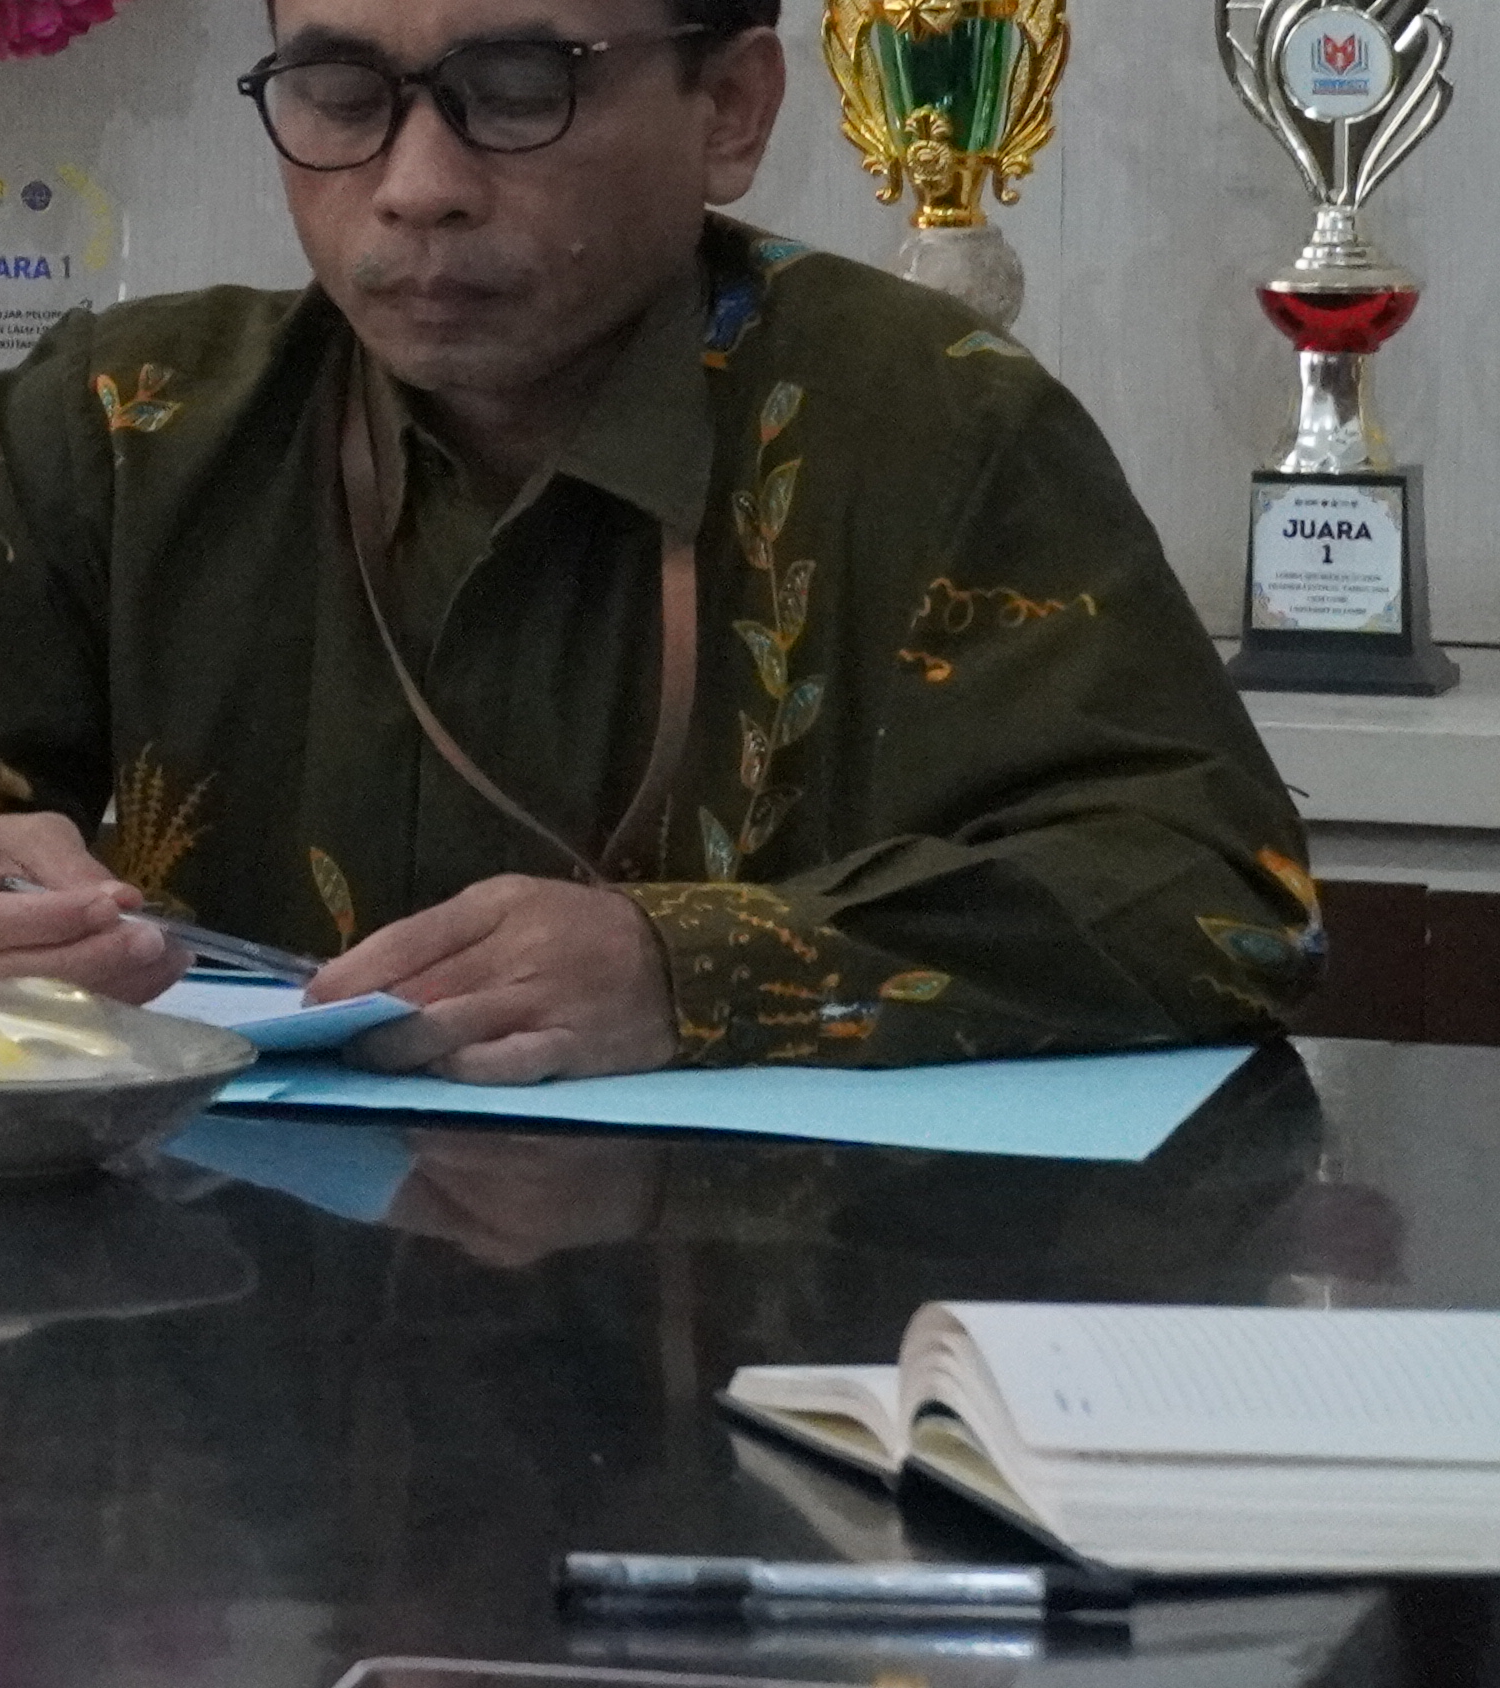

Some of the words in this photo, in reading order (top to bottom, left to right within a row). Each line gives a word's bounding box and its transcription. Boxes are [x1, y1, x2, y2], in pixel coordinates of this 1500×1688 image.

[61, 255, 71, 279] 1
[1283, 519, 1372, 540] JUARA
[1322, 543, 1334, 564] 1
